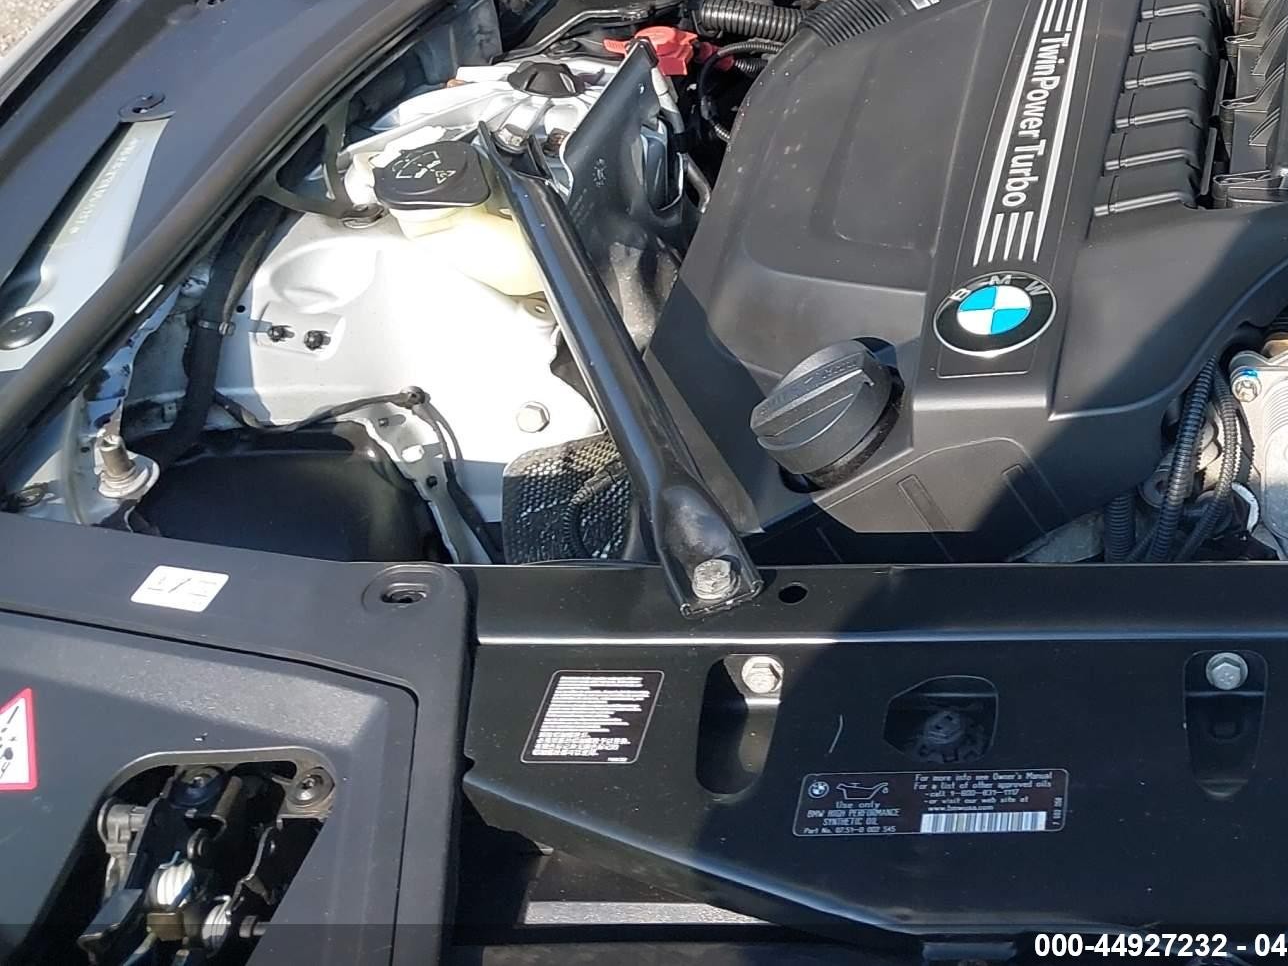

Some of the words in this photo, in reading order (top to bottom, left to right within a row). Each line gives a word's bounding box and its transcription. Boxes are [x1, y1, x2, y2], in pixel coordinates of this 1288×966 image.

[1018, 33, 1071, 139] TwinPower
[1002, 139, 1047, 207] Turbo
[950, 274, 1048, 301] BMW
[915, 774, 929, 782] For
[993, 772, 1022, 780] Owner's
[914, 782, 928, 790] For
[959, 781, 968, 789] of
[997, 781, 1032, 789] approved
[858, 800, 880, 809] only
[807, 810, 825, 818] BMW
[848, 808, 900, 817] PERFORMANCE
[823, 818, 863, 826] SYNTHETIC
